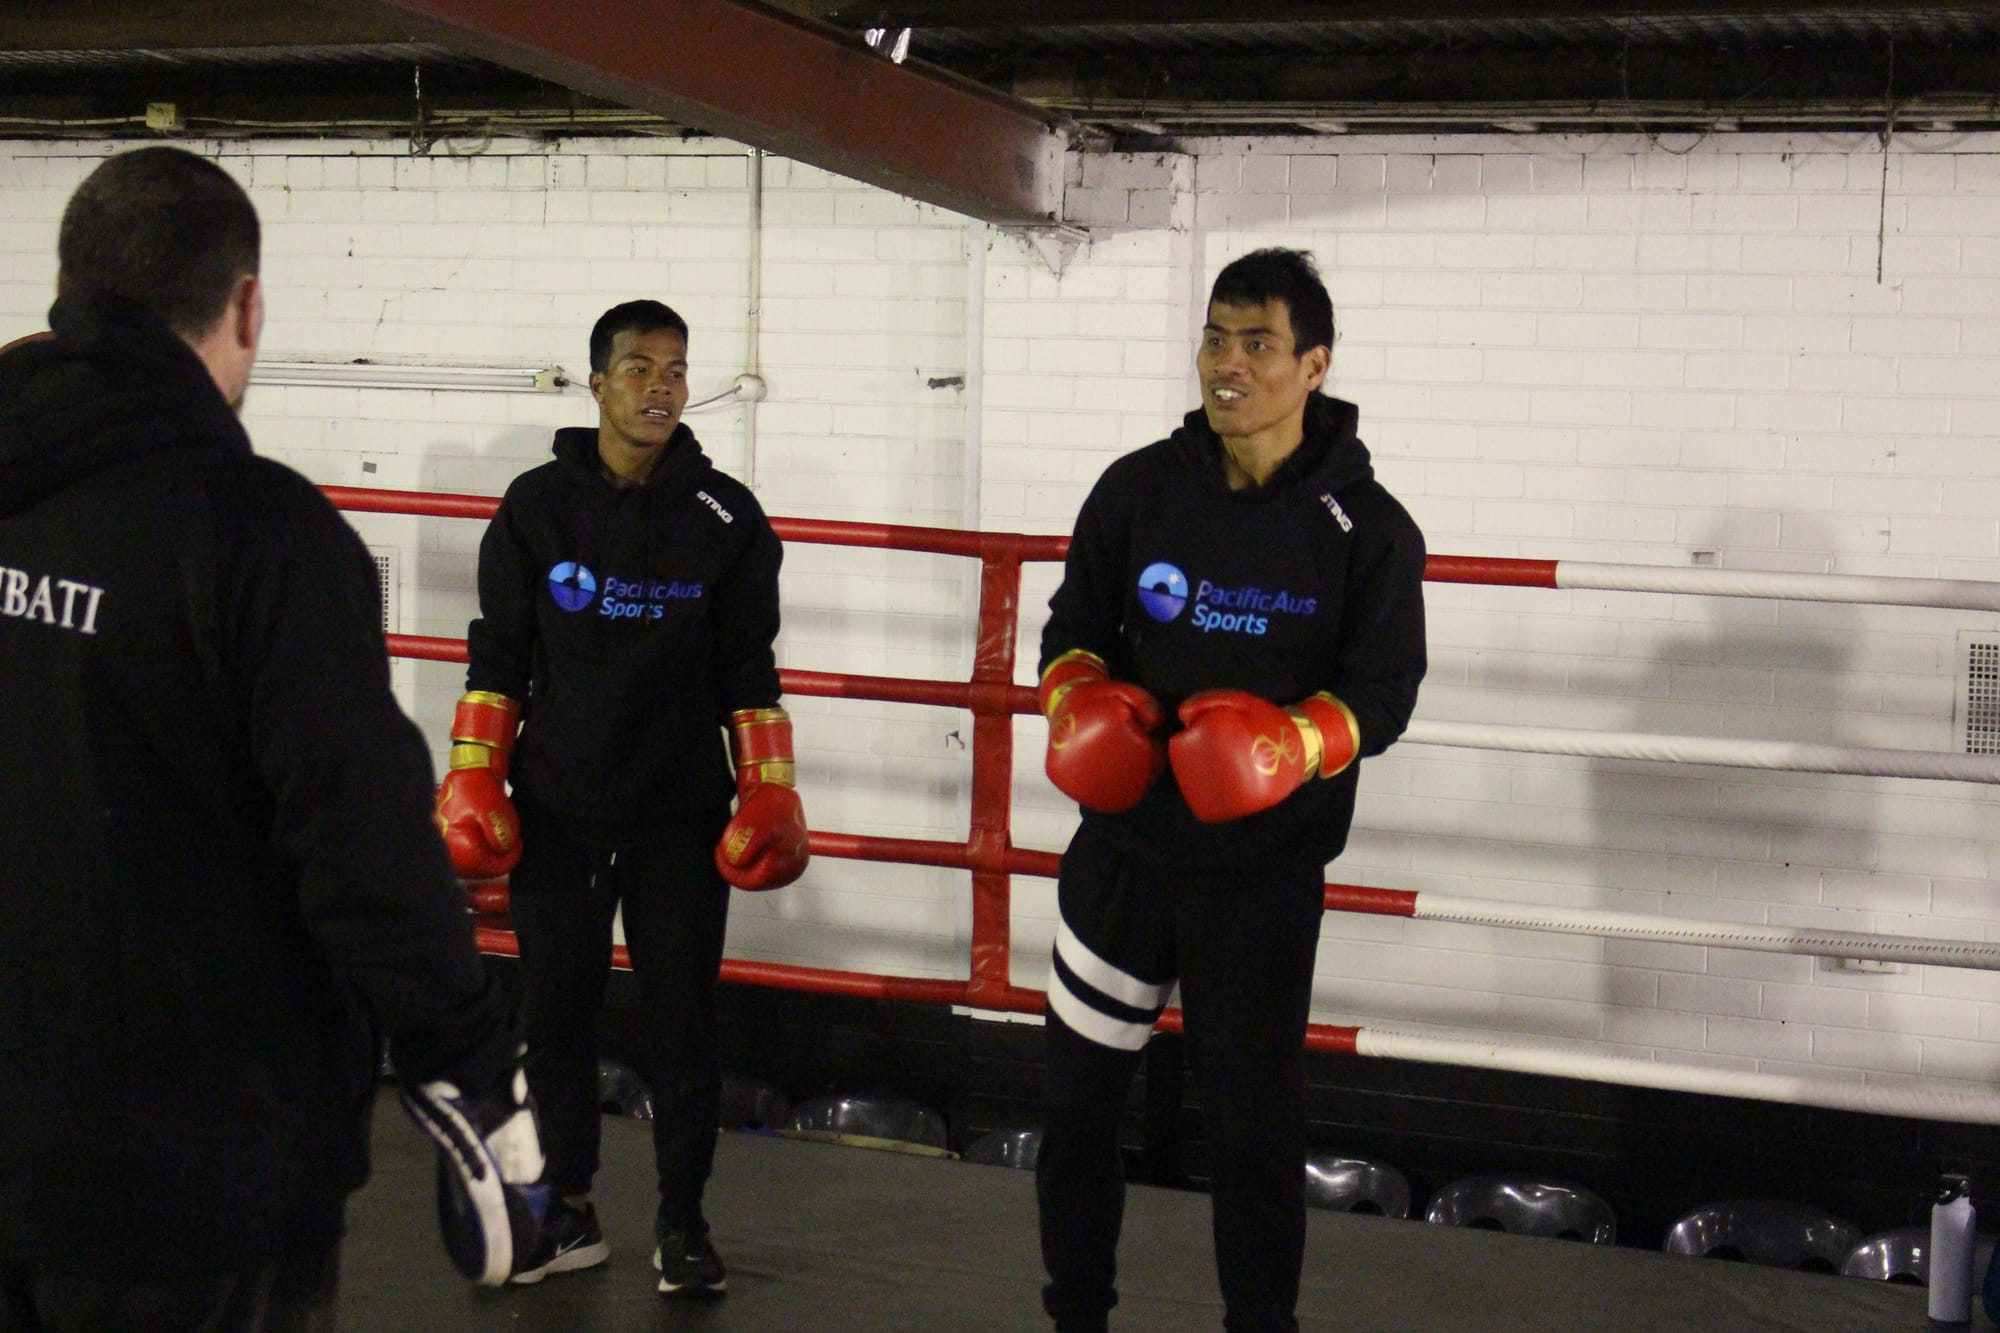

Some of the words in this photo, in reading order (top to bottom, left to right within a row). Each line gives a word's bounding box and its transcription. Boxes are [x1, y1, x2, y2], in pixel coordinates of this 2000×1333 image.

[696, 490, 734, 524] STING
[1320, 492, 1353, 533] STING
[602, 577, 703, 600] PaciicAus
[1195, 580, 1317, 616] PacificAus
[600, 597, 664, 620] Spors
[1191, 603, 1268, 635] Sports
